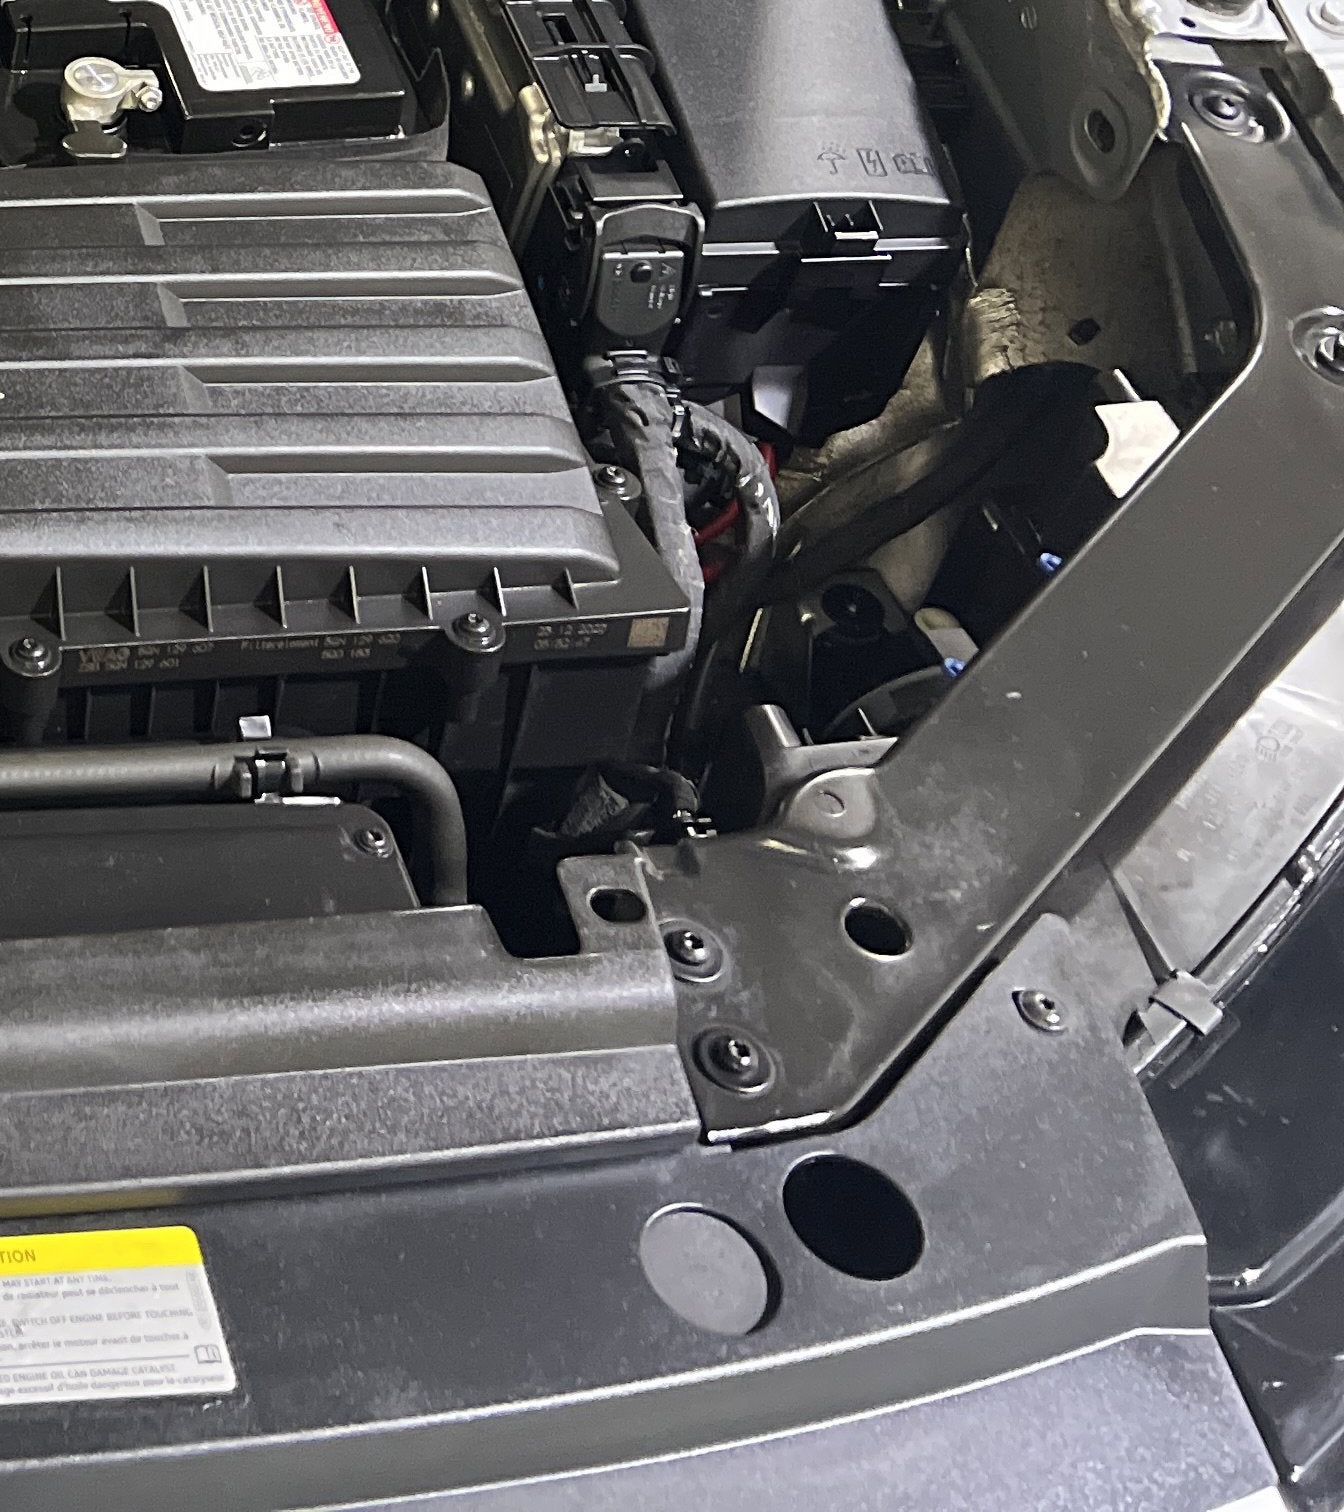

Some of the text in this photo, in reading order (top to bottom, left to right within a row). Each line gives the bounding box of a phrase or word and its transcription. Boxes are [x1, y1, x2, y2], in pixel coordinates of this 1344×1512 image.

[2, 1278, 22, 1288] MAY
[24, 1276, 51, 1287] START
[53, 1275, 65, 1285] AT
